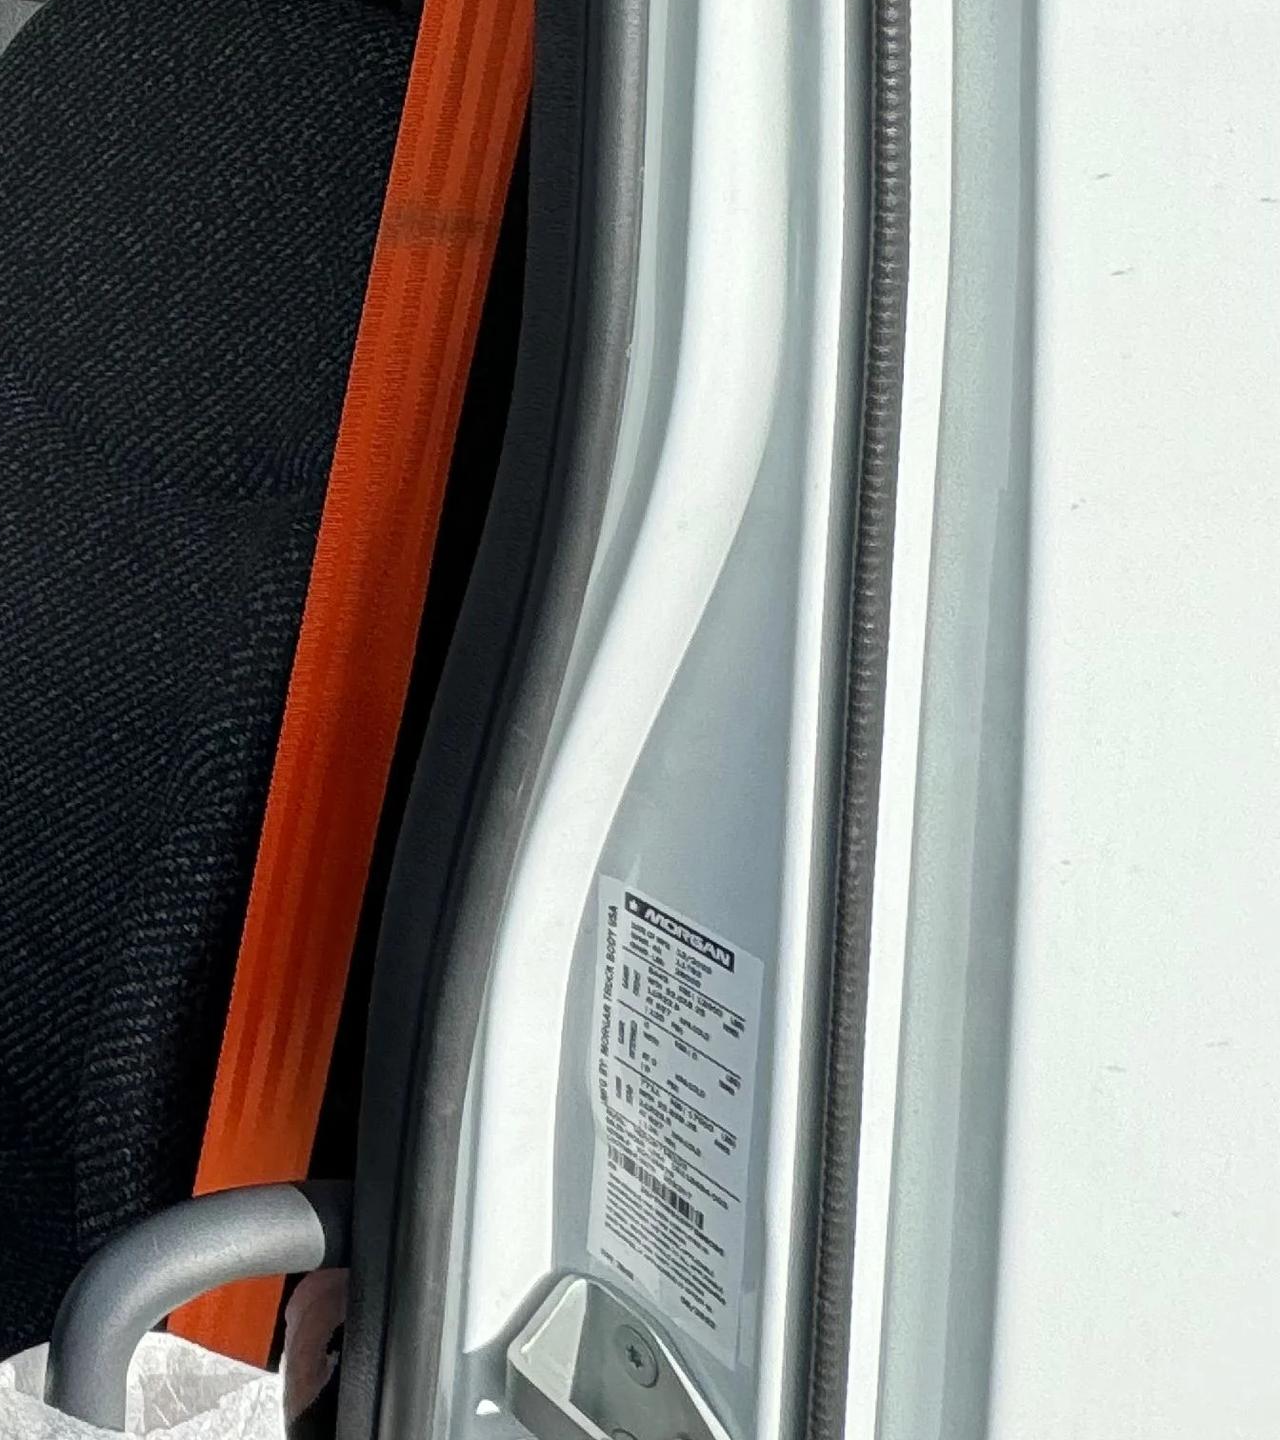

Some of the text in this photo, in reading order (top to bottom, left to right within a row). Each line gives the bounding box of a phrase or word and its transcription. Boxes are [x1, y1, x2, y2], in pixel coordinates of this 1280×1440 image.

[608, 905, 618, 928] USA
[606, 928, 617, 963] BODY
[644, 909, 731, 967] MORGAN
